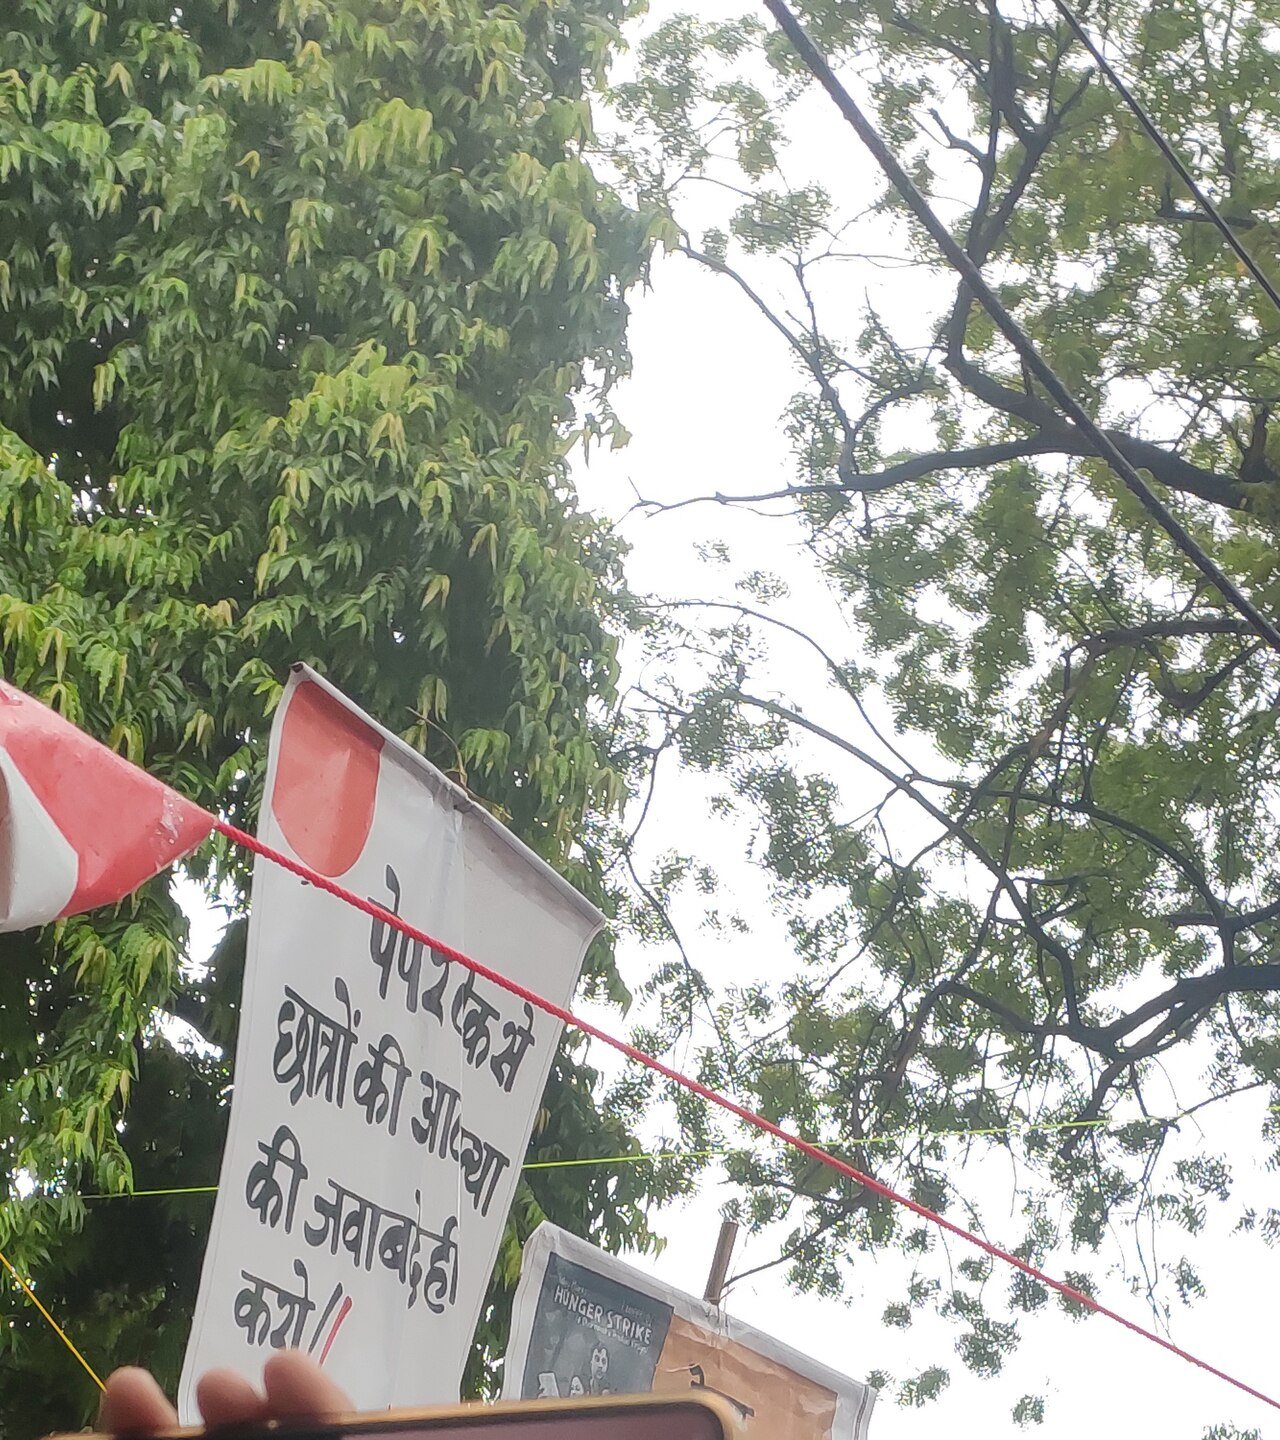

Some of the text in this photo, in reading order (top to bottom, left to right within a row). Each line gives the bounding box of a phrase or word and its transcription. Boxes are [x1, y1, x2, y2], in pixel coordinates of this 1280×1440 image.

[353, 1033, 413, 1136] की
[246, 1124, 308, 1235] की
[554, 1285, 604, 1323] HUNGER
[606, 1309, 653, 1346] STRIKE
